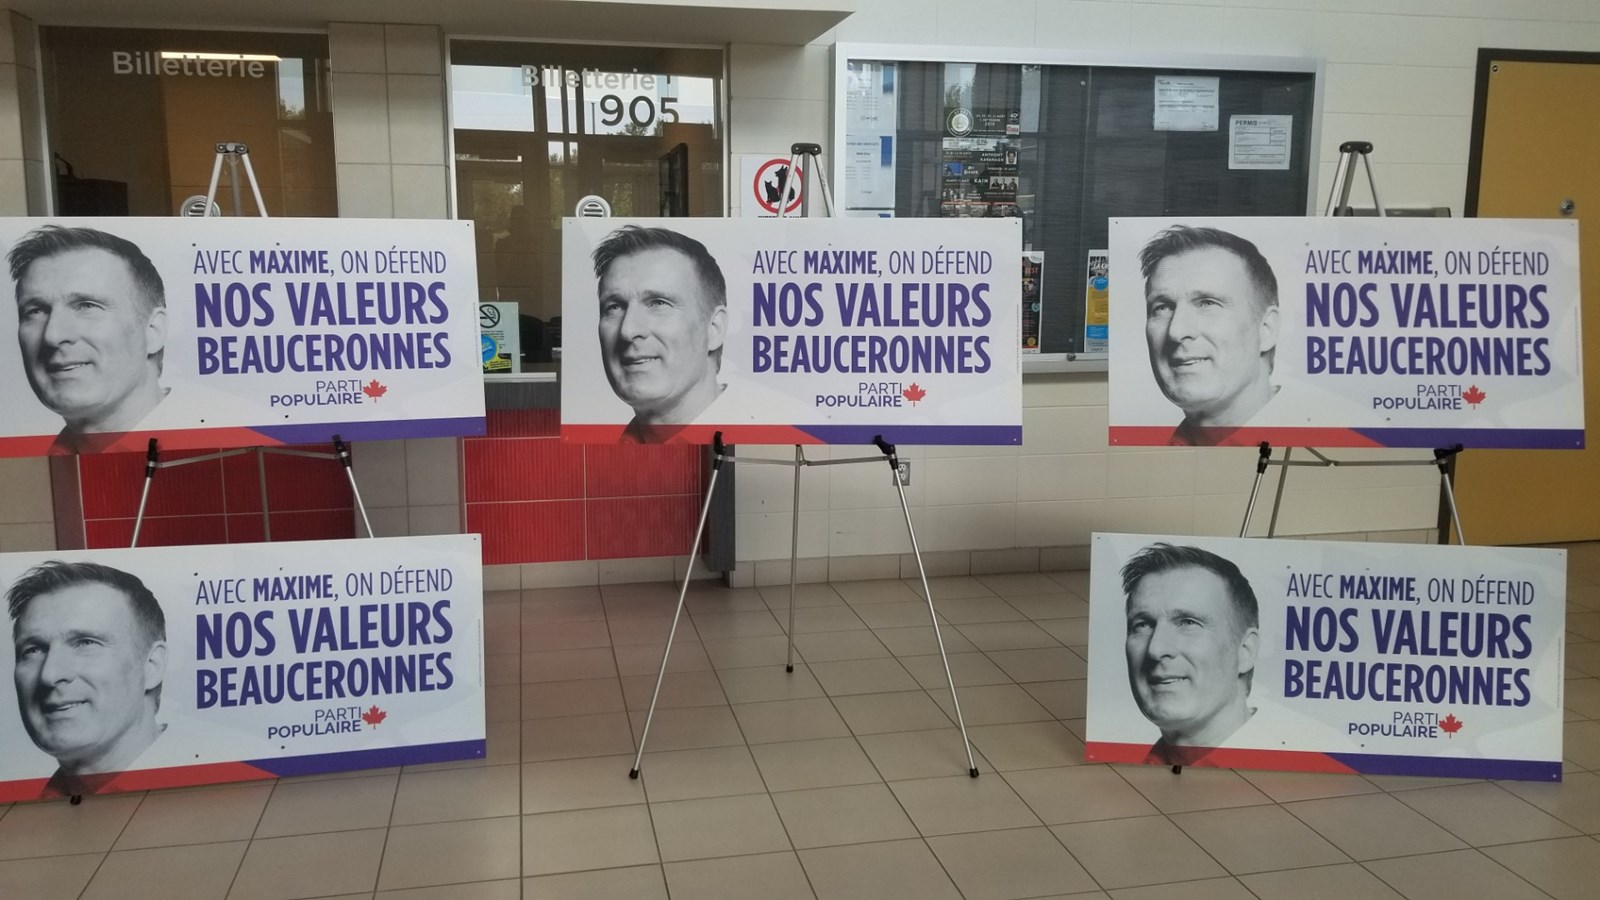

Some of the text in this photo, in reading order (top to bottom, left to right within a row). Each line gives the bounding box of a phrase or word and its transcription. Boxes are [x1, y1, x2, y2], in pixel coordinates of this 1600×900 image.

[112, 50, 265, 79] Billetterie
[520, 64, 656, 91] Billetterie
[599, 94, 681, 128] 905
[1235, 119, 1258, 127] PERMIS
[194, 246, 447, 277] AVEC MAXIME, ON DÉFEND
[752, 245, 993, 278] AVEC MAXIME, ON DÉFEND
[1305, 246, 1550, 279] AVEC MAXIME, ON DÉFEND
[194, 281, 449, 329] NOS VALEURS
[752, 281, 825, 328] NOS
[834, 282, 993, 328] VALEURS
[1305, 282, 1551, 330] NOS VALEURS
[196, 331, 452, 376] BEAUCERONNES
[752, 334, 992, 374] BEAUCERONNES
[1306, 335, 1552, 377] BEAUCERONNES
[269, 392, 364, 408] POPULAIRE
[315, 379, 363, 393] PARTI
[815, 394, 903, 408] POPULAIRE
[858, 382, 903, 395] PARTI
[1416, 384, 1462, 398] PARTI
[1372, 396, 1463, 411] POPULAIRE
[194, 565, 453, 606] AVEC MAXIME, ON DÉFEND
[1285, 572, 1536, 607] AVEC MAXIME, ON DÉFEND
[195, 609, 277, 662] NOS
[287, 599, 454, 655] VALEURS
[1284, 605, 1534, 661] NOS VALEURS
[195, 651, 454, 710] BEAUCERONNES
[1283, 658, 1532, 708] BEAUCERONNES
[267, 720, 362, 740] POPULAIRE
[314, 706, 362, 724] PARTI
[1348, 722, 1439, 739] POPULAIRE
[1392, 711, 1439, 726] PARTI
